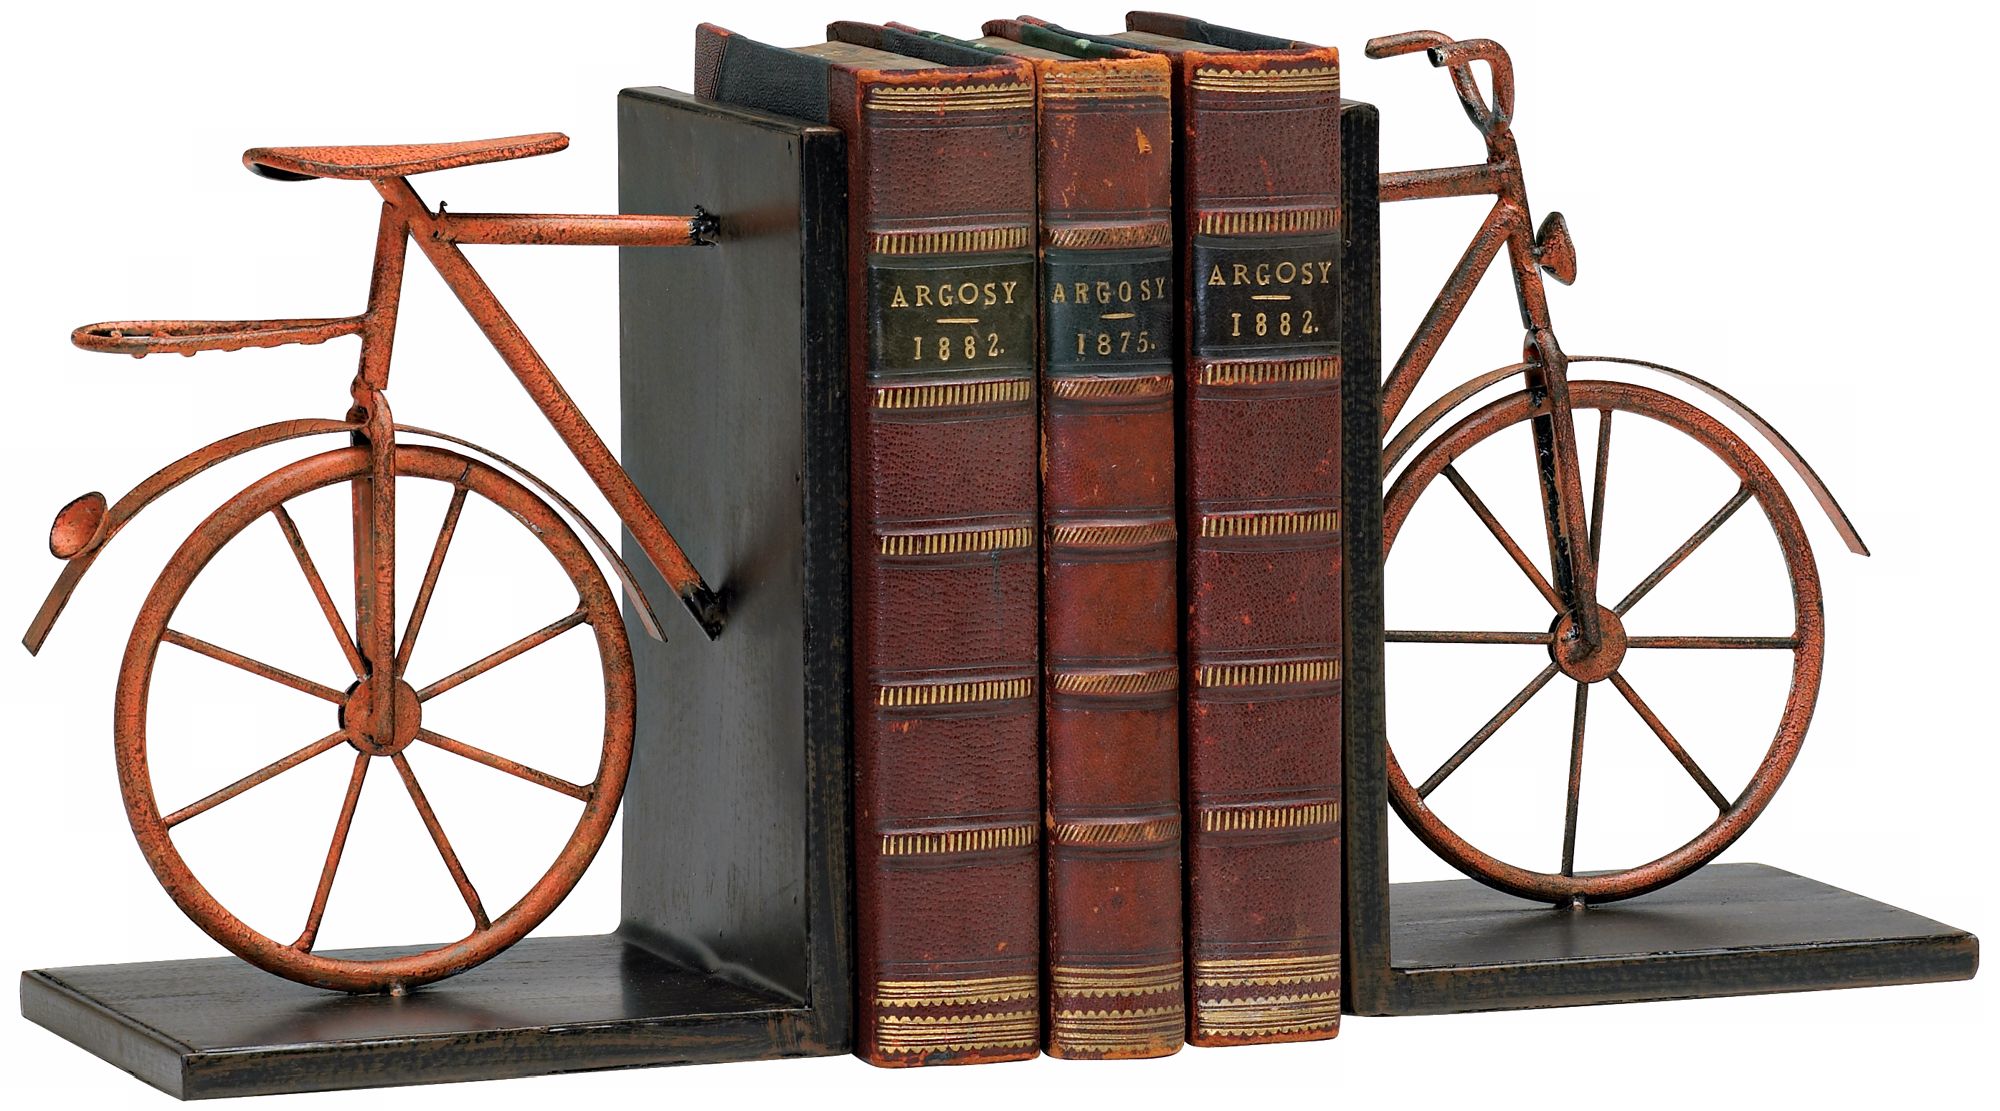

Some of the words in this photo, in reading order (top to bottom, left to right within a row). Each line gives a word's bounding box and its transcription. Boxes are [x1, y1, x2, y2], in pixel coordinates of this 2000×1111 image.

[1208, 260, 1332, 287] ARGOSY
[890, 280, 1017, 308] ARGOSY
[1052, 276, 1166, 305] ARGOSY
[1231, 310, 1319, 337] 1882.
[913, 332, 1005, 361] 1882.
[1076, 330, 1156, 356] 1875.
